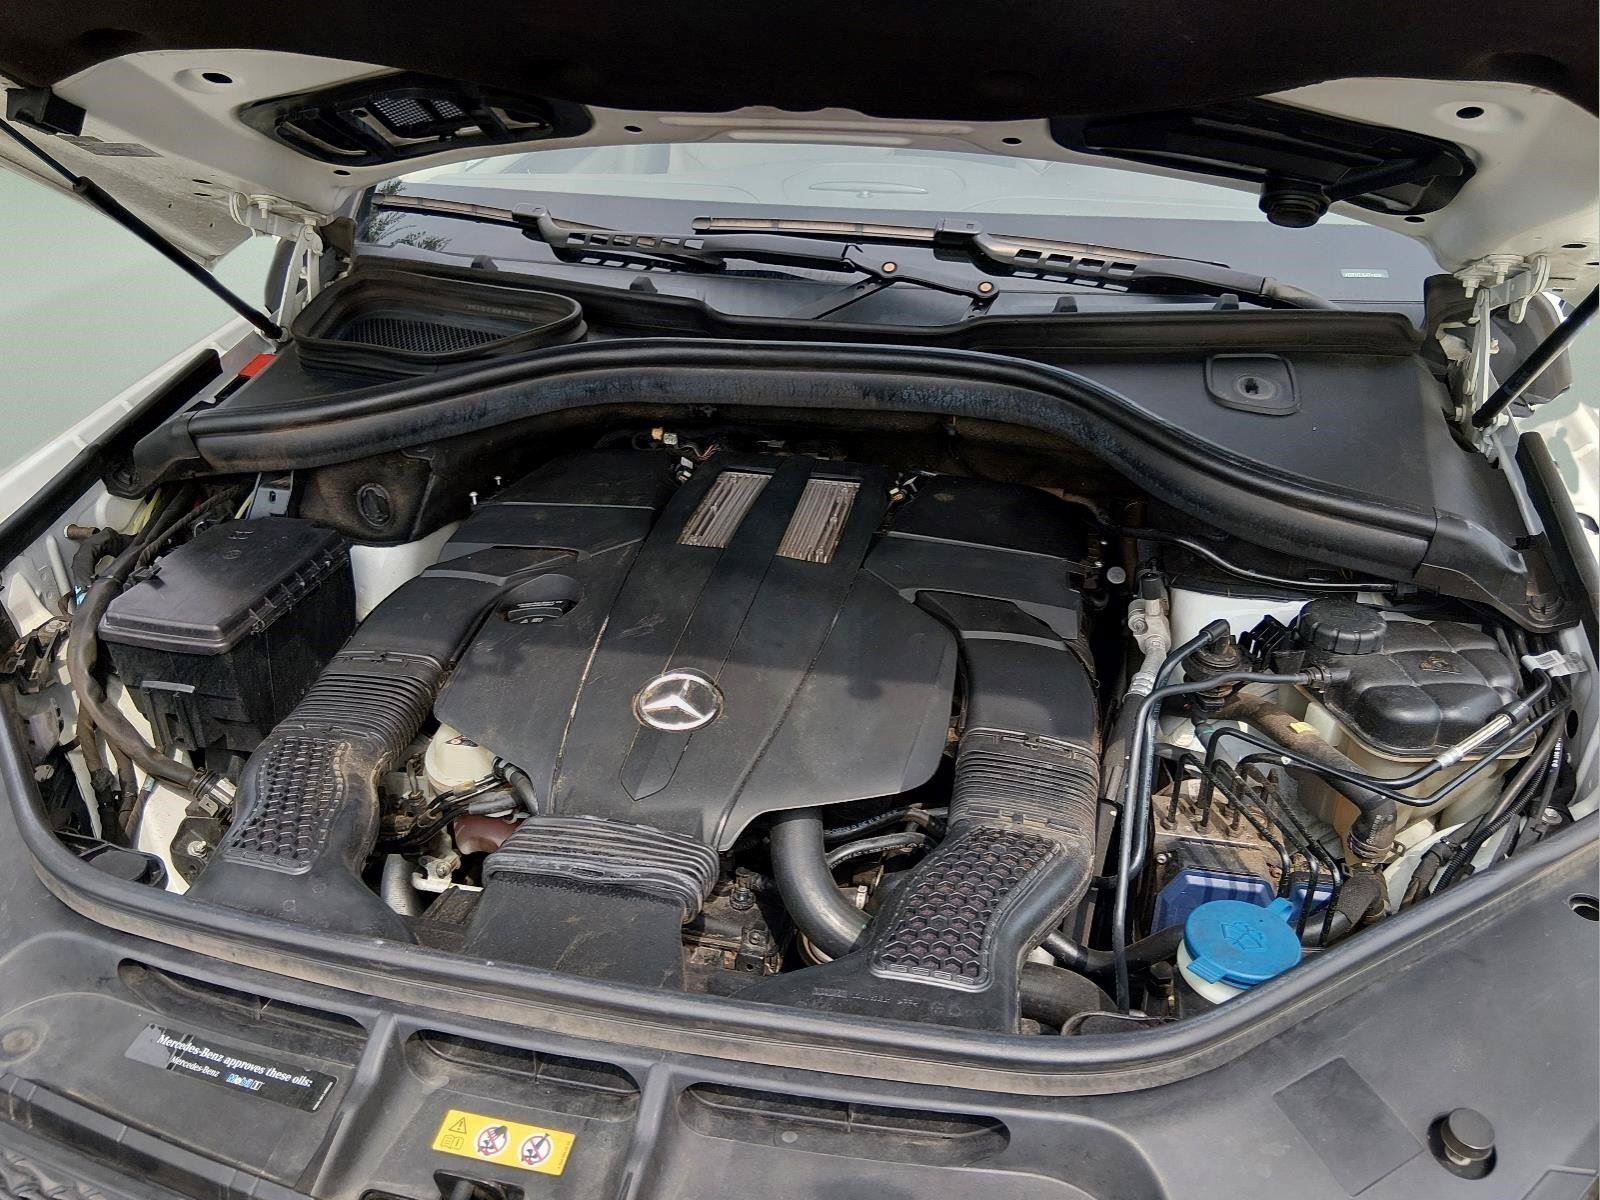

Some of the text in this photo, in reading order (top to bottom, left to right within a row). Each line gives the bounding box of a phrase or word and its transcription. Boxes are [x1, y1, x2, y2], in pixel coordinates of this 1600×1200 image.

[157, 1034, 313, 1088] Mercedes-Benz approves these oils:
[171, 1056, 220, 1078] Mercedes-Benz
